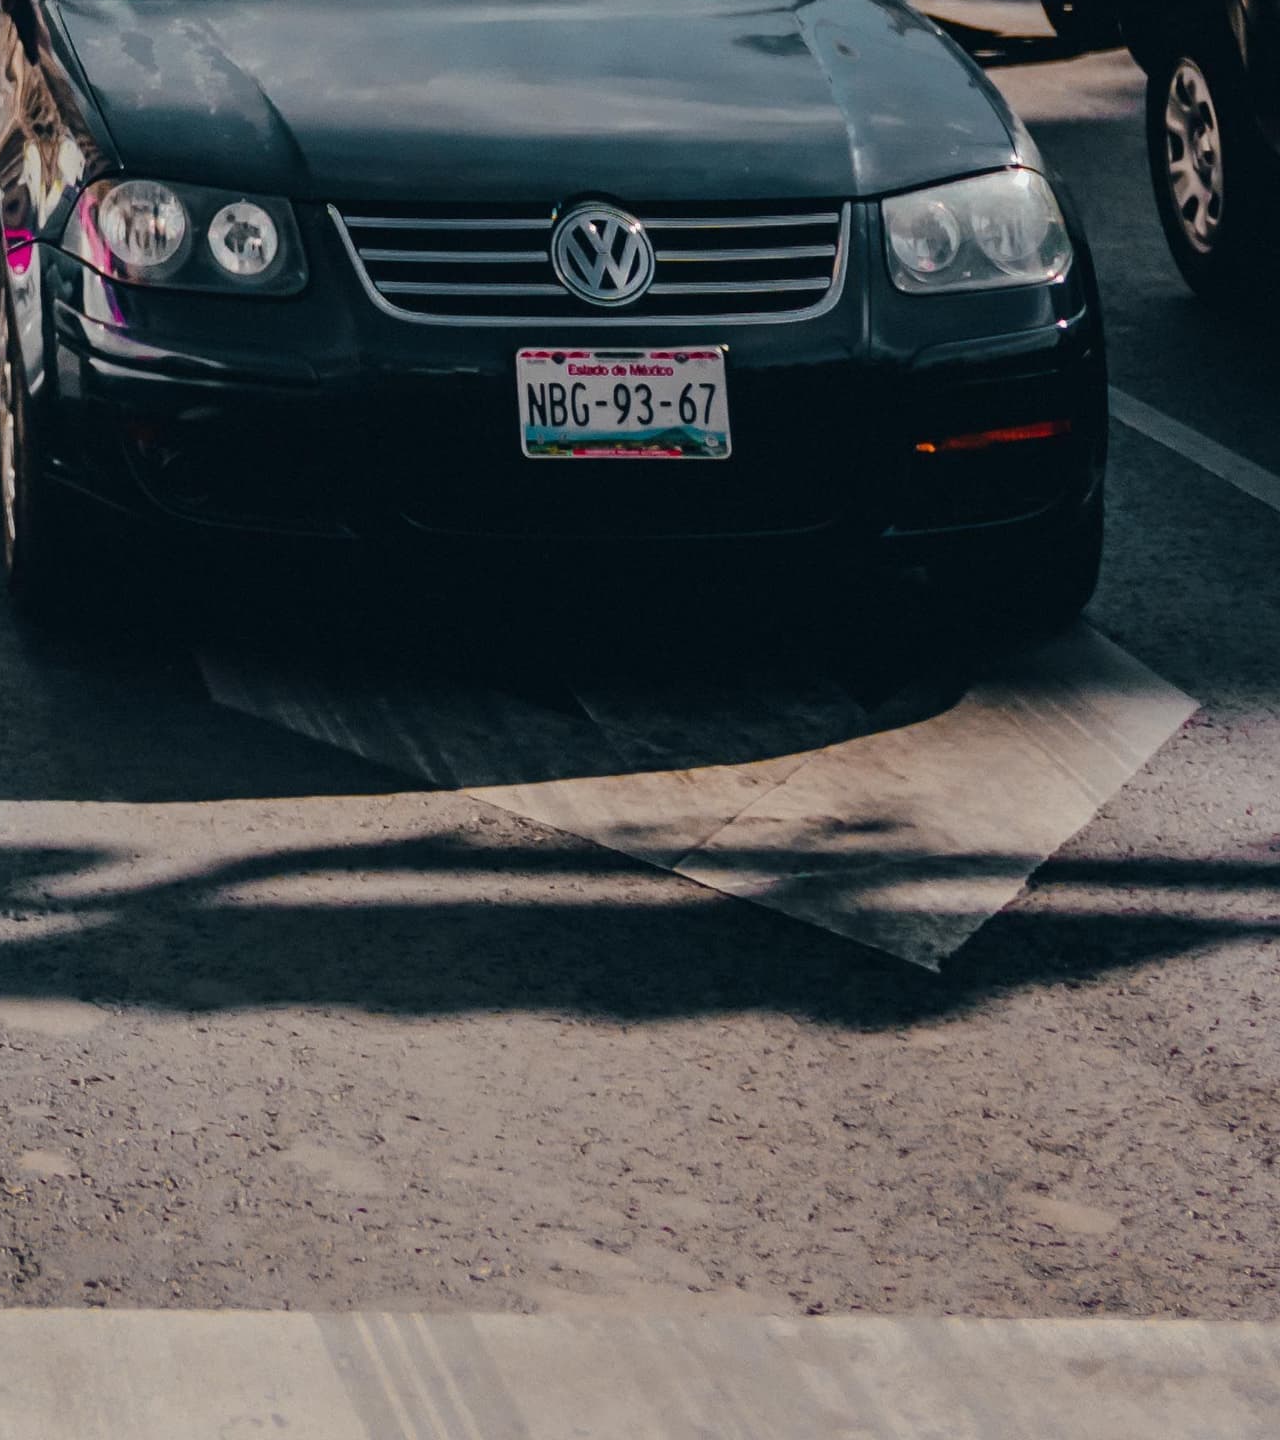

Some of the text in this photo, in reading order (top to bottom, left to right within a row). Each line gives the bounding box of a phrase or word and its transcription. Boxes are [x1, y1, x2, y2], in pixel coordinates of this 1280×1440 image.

[567, 364, 674, 377] Estado de México
[526, 382, 717, 427] NBG-93-67
